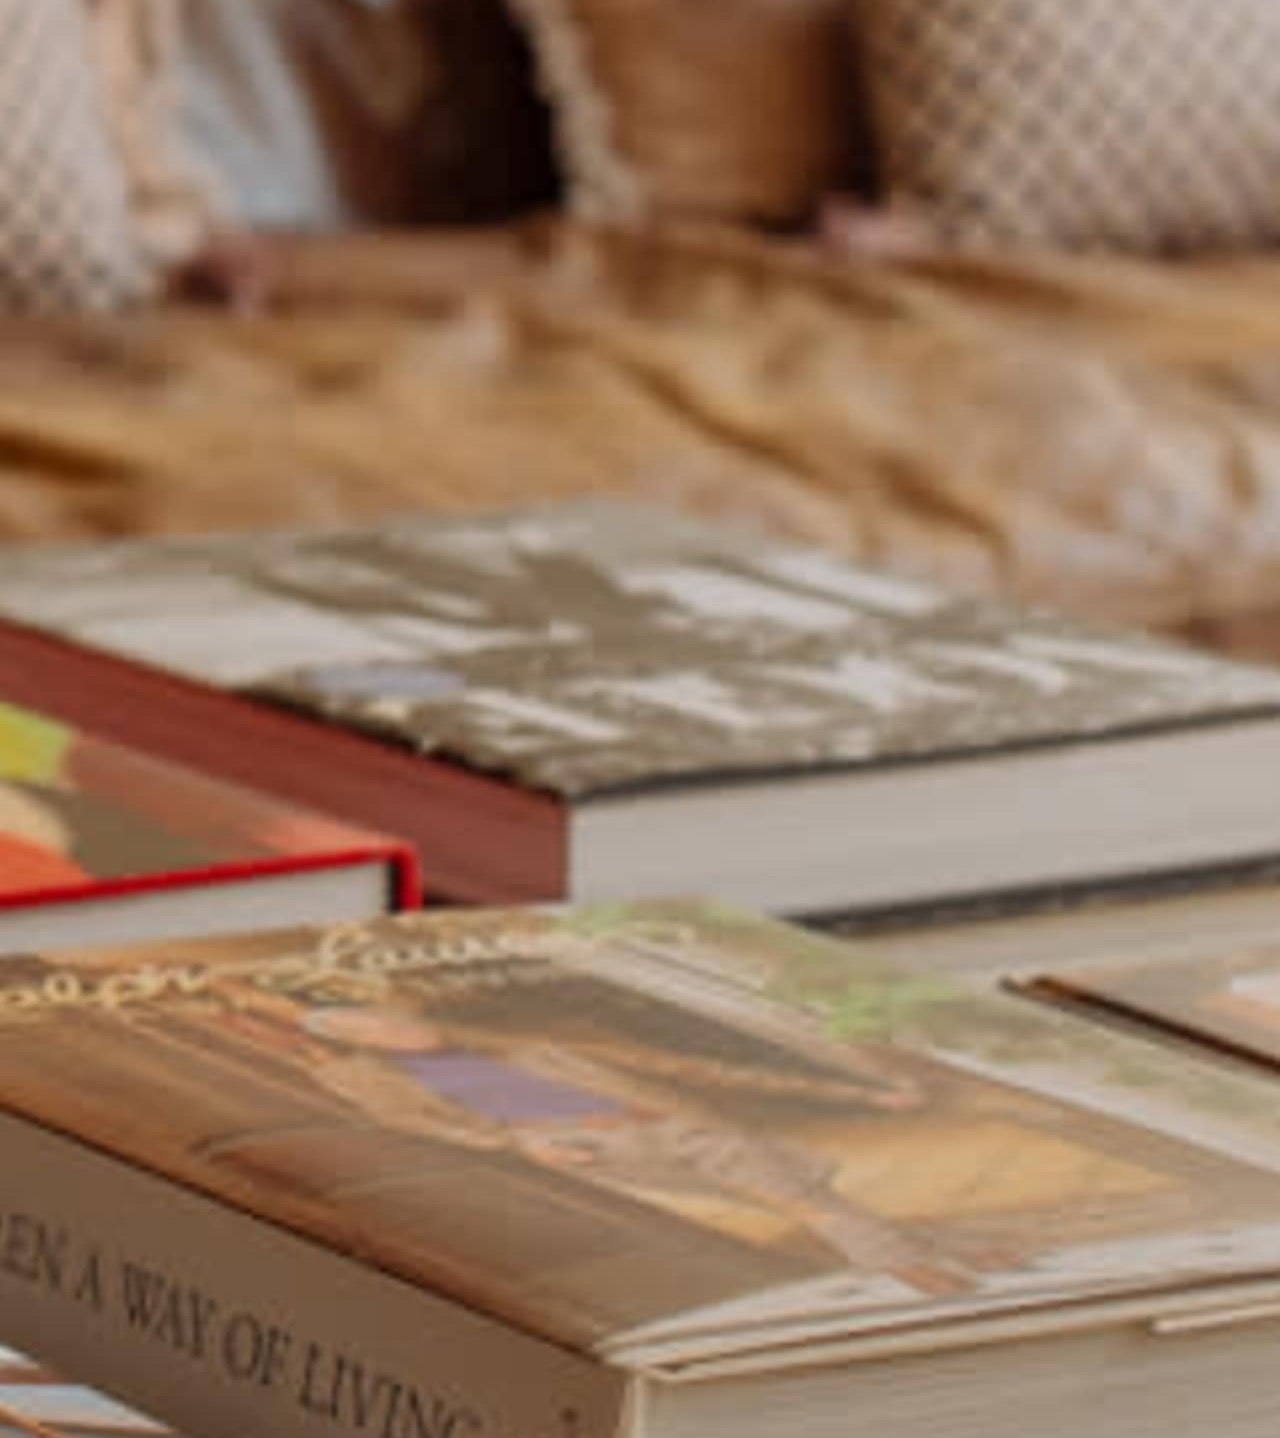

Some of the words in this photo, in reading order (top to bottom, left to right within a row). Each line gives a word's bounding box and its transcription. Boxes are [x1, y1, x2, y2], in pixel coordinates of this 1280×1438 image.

[74, 1247, 103, 1306] A
[119, 1257, 216, 1360] WAY
[224, 1310, 287, 1398] OF
